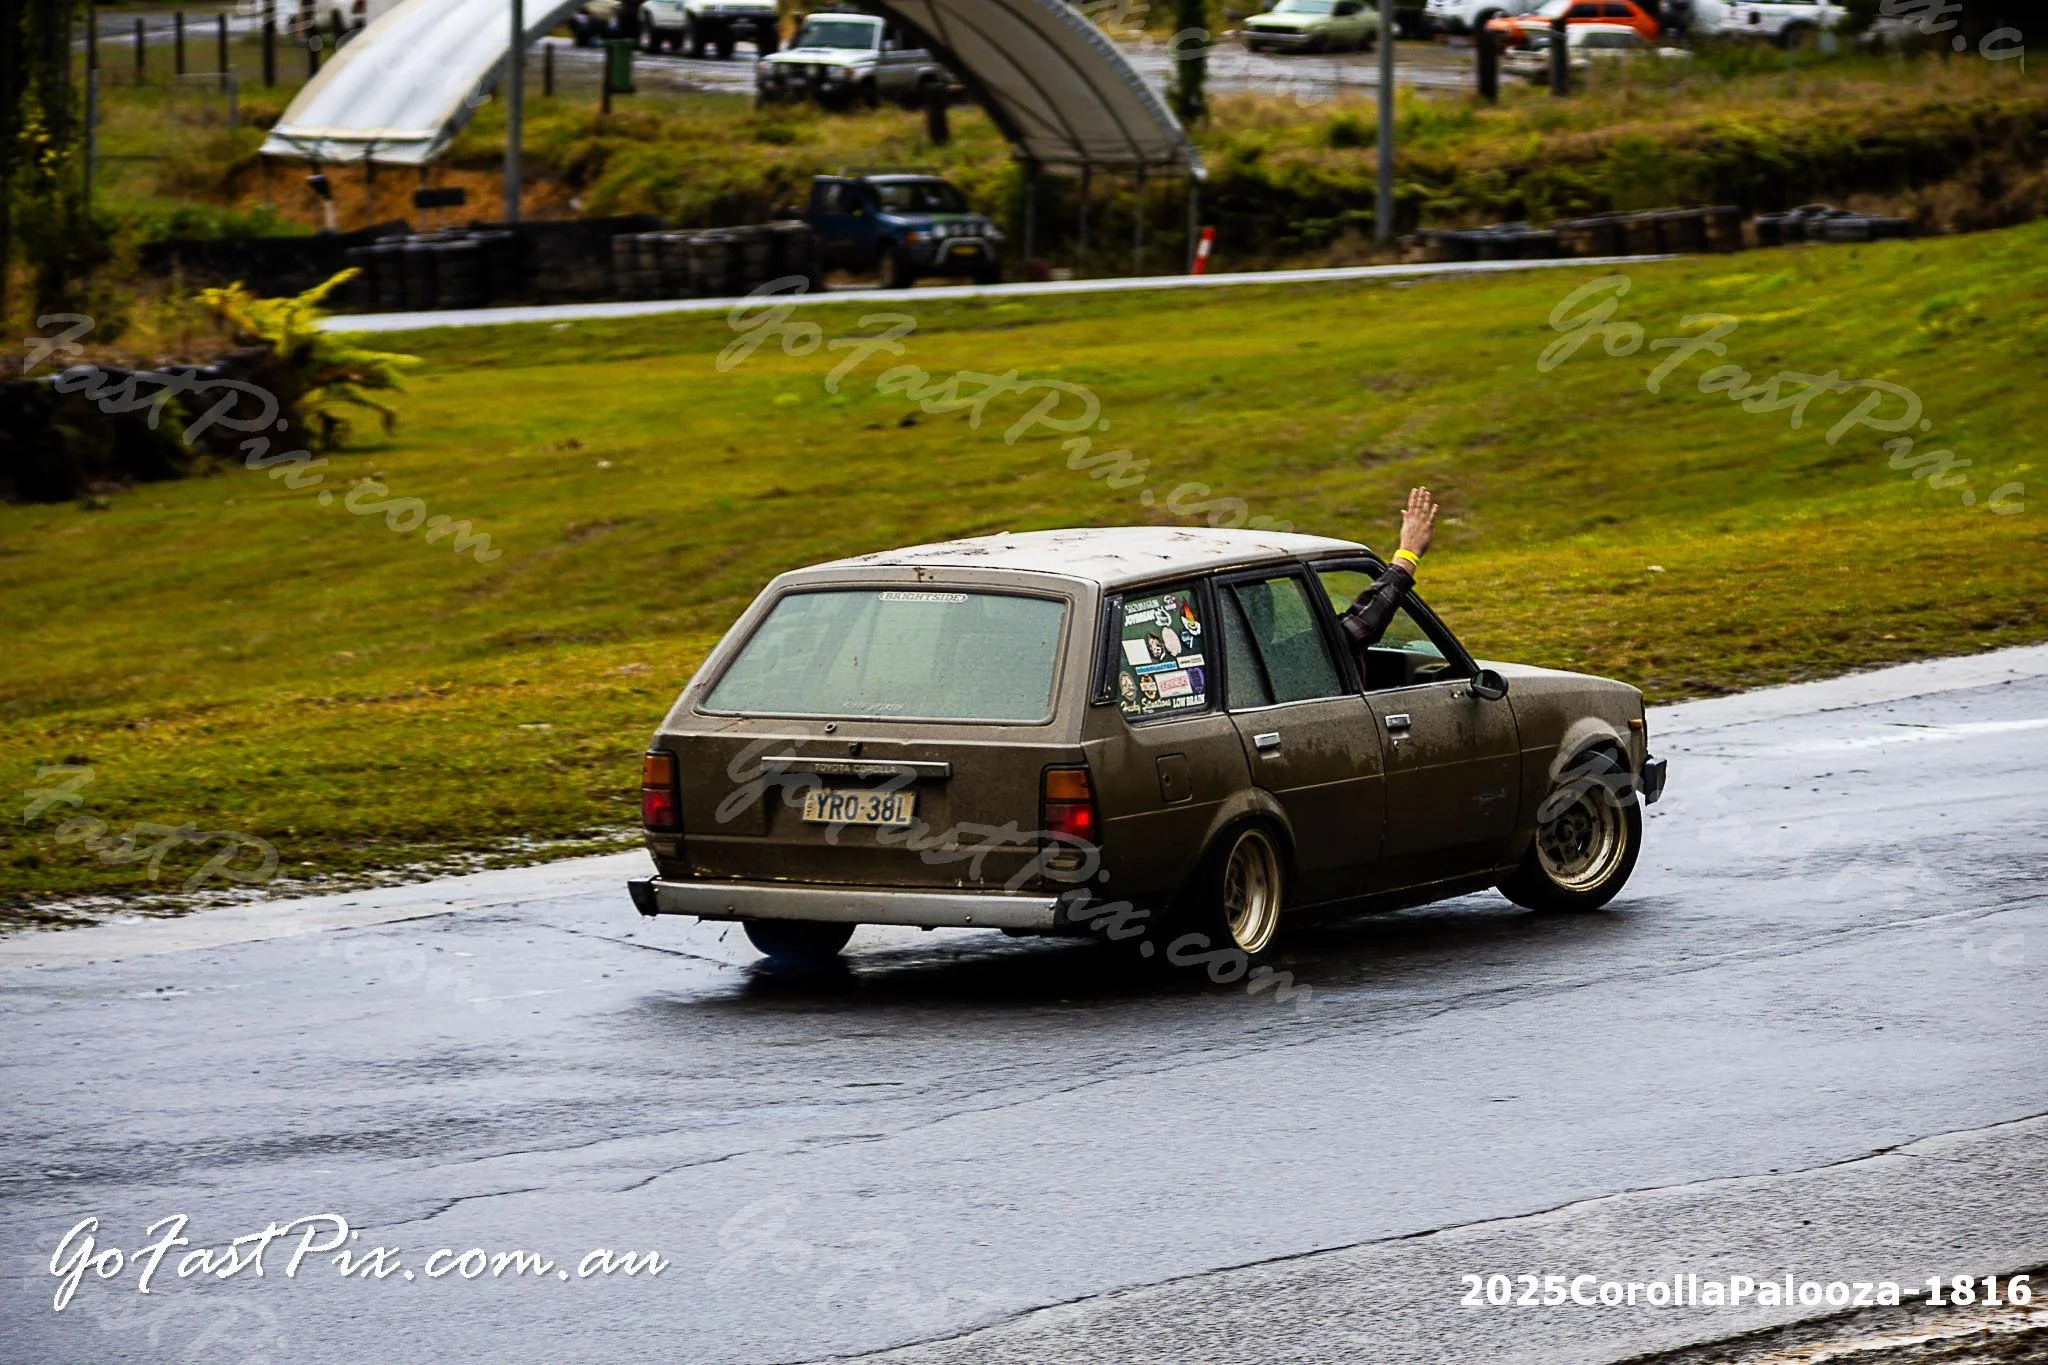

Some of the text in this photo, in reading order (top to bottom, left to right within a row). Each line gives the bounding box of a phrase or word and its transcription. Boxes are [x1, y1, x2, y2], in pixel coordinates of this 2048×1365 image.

[884, 592, 962, 602] BRIGHTSIDE
[814, 763, 897, 774] TOYOTA COROLLA
